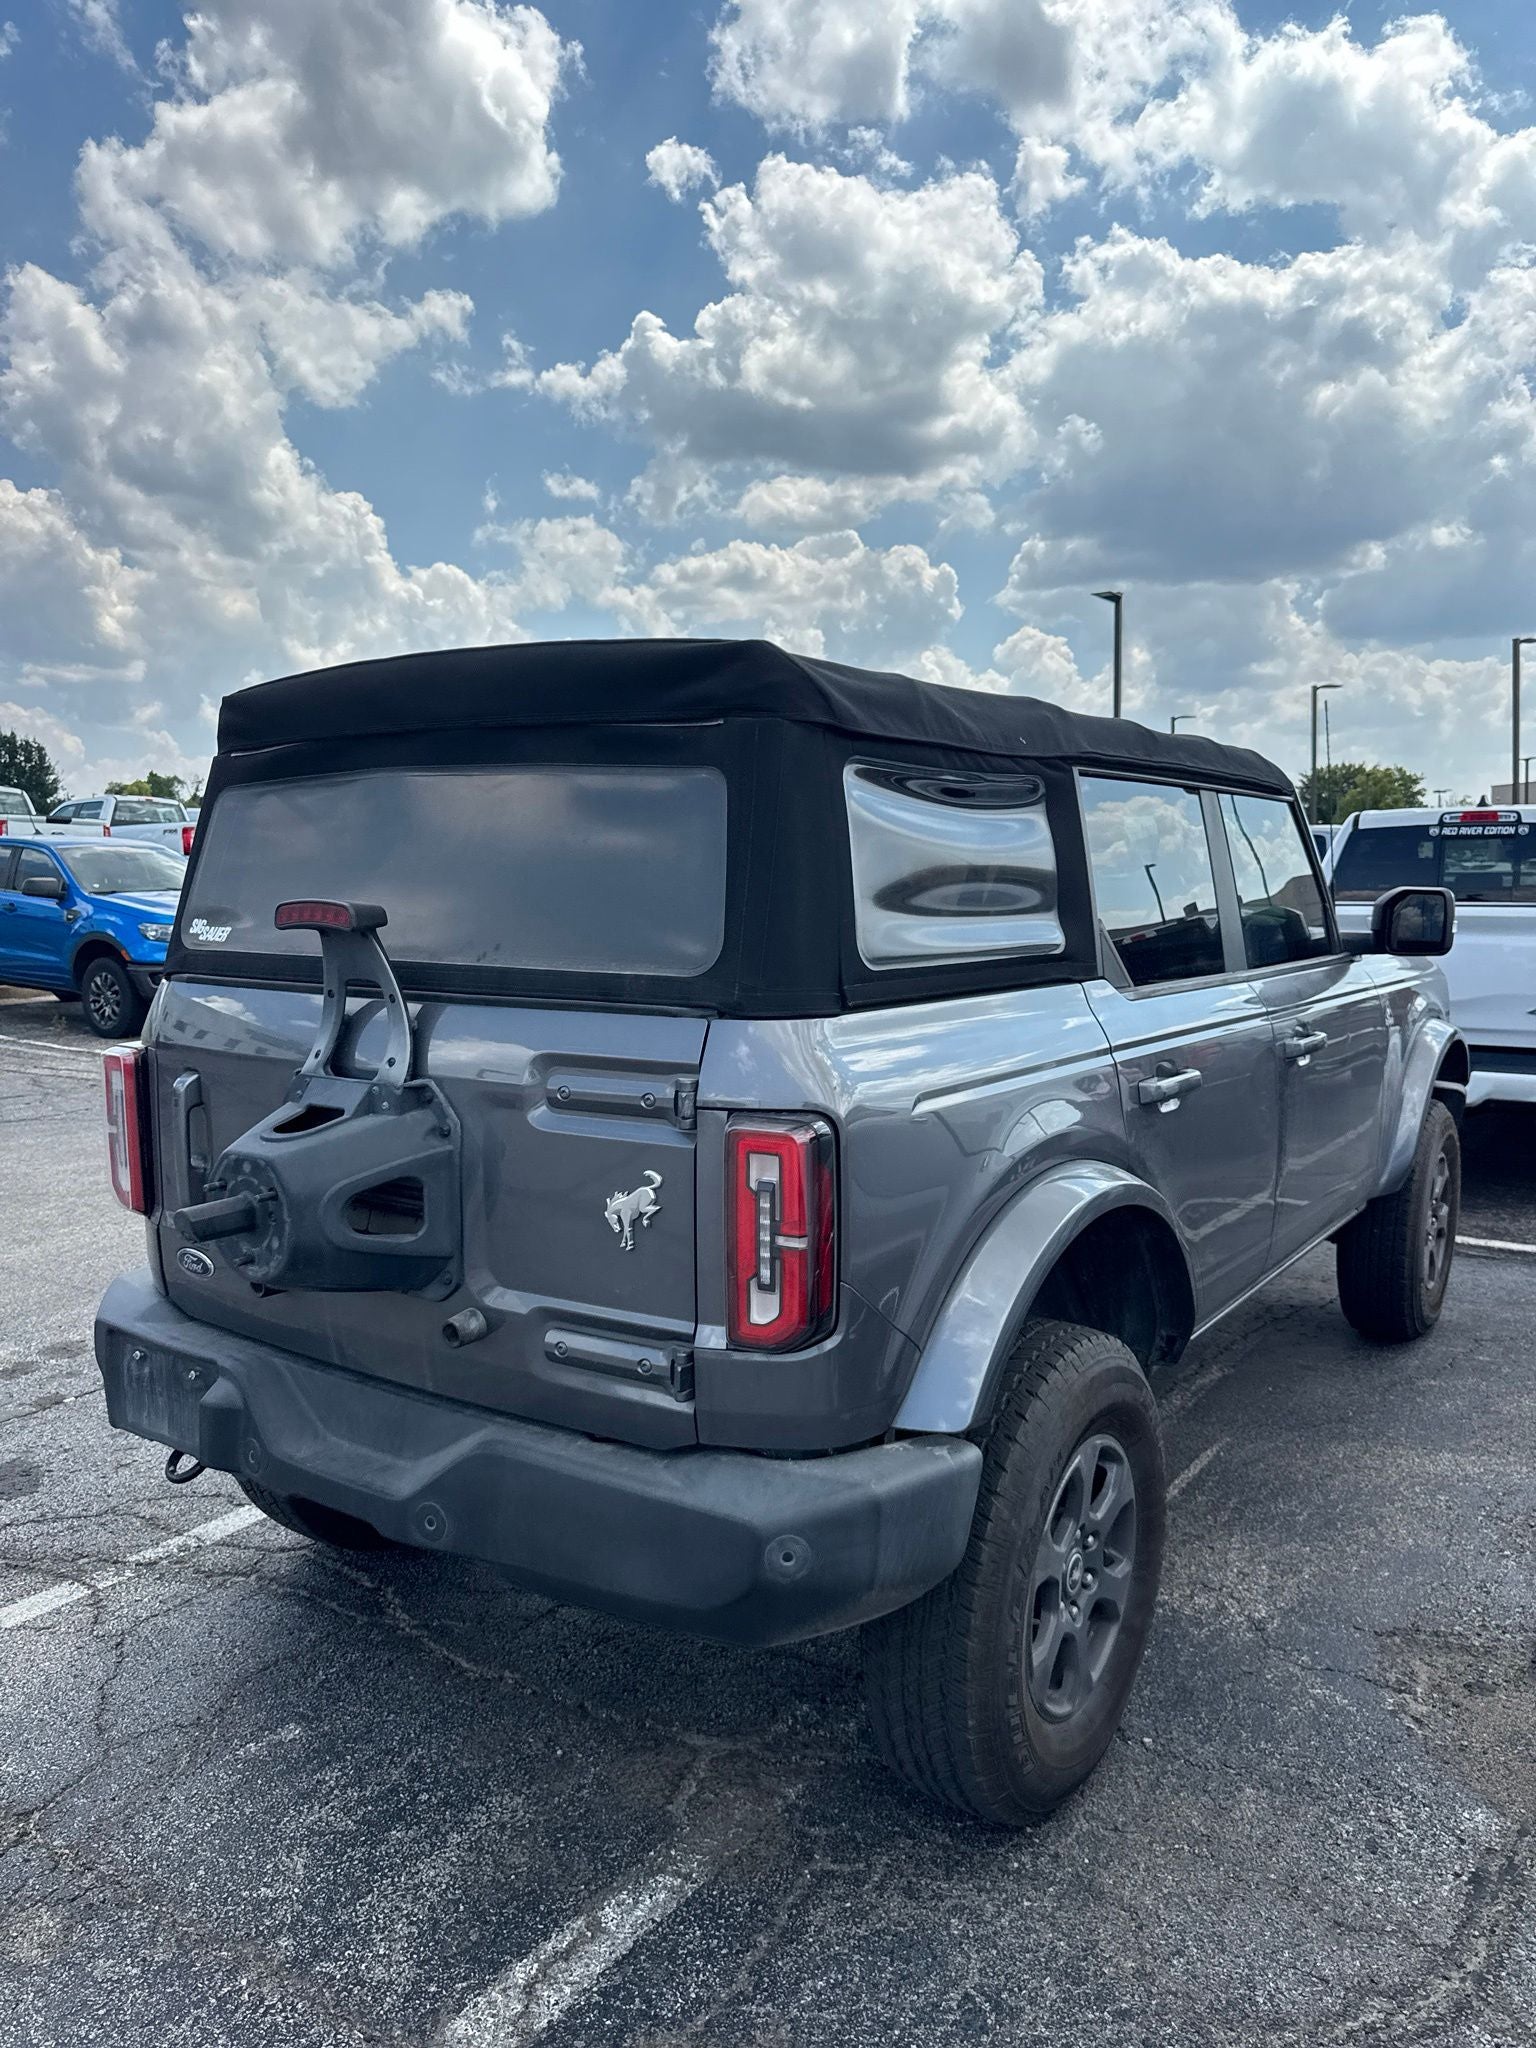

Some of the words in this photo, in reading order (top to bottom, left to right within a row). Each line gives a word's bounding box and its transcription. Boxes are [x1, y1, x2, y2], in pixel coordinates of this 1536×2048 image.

[1441, 826, 1459, 836] RED
[1459, 826, 1483, 836] RIVER
[1484, 826, 1516, 835] EDITION
[190, 918, 208, 934] SIG
[199, 926, 232, 942] SAUER
